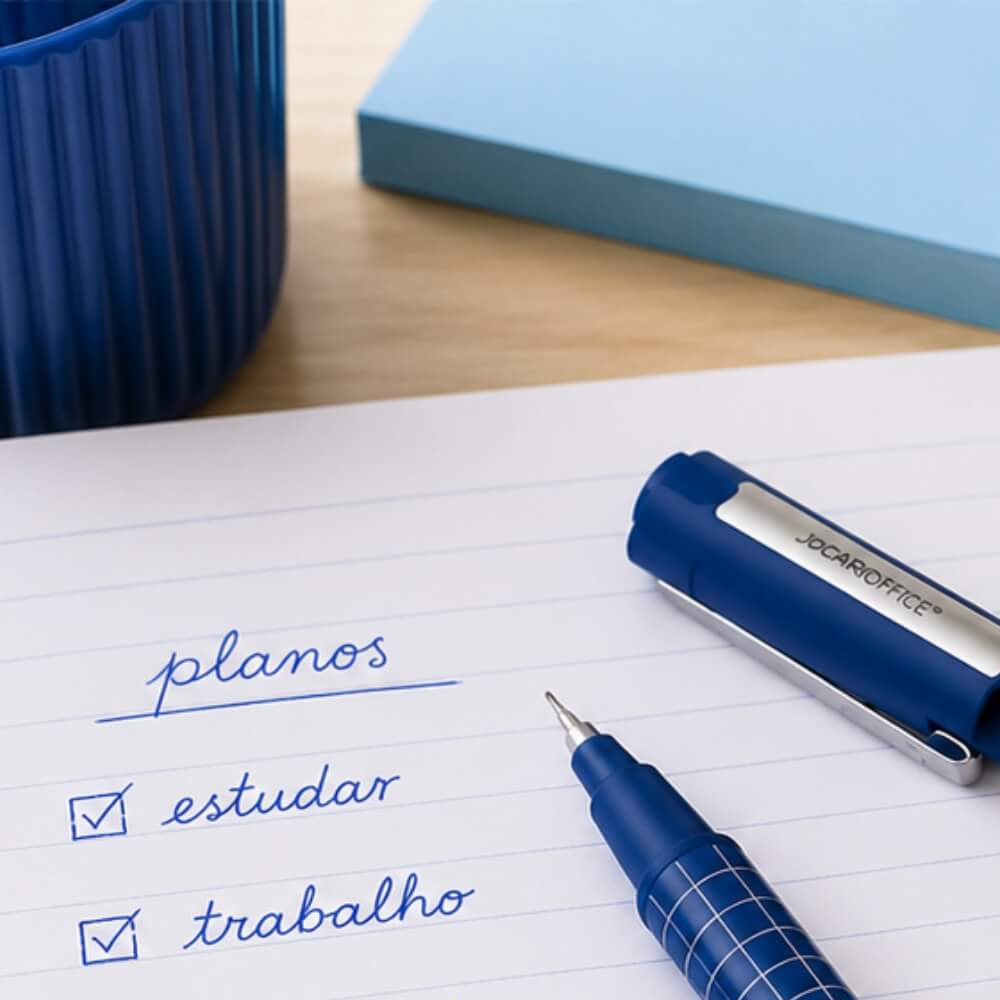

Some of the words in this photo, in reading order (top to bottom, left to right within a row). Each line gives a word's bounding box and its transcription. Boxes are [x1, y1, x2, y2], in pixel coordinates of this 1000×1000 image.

[146, 629, 389, 717] planos
[160, 764, 400, 825] estudar
[182, 873, 475, 949] trabalho
